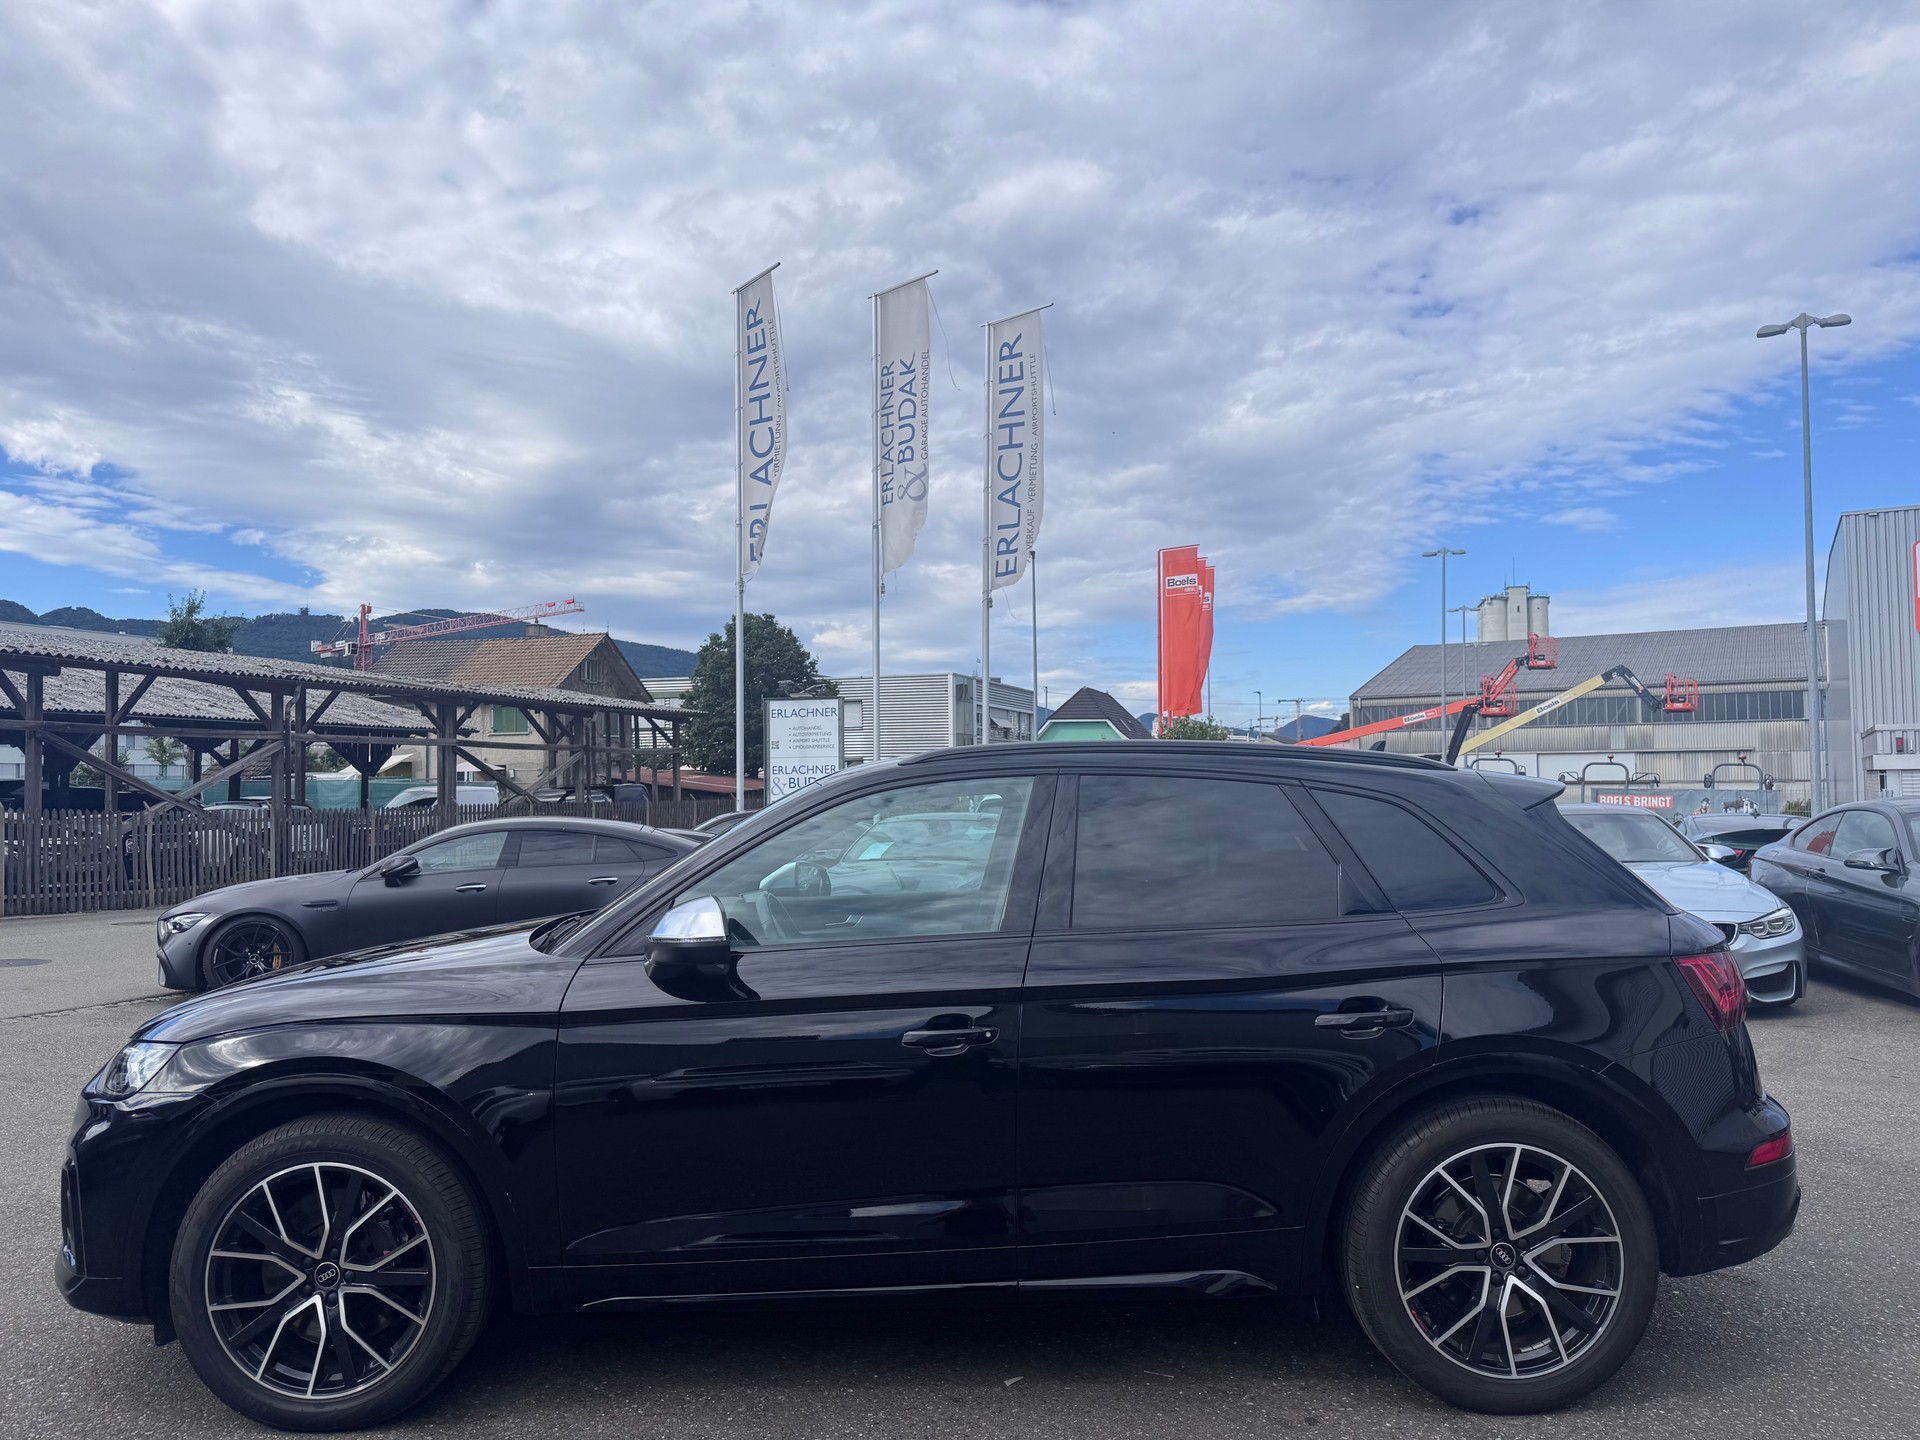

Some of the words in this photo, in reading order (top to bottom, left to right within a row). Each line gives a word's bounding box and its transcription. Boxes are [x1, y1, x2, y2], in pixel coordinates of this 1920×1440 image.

[898, 352, 917, 465] BUDAK
[921, 349, 930, 418] AUTOHANDEL
[1029, 352, 1038, 436] AIRPORTSHUTTLE
[773, 415, 782, 478] ERMIETUNG
[881, 360, 895, 505] ERLACHNER
[920, 419, 929, 460] GARAGE
[995, 332, 1025, 578] ERLACHNER
[1027, 443, 1039, 503] VERMIETUNG
[1025, 509, 1036, 550] VERKAUF
[1167, 576, 1197, 587] Boels
[771, 707, 838, 718] ERLACHNER
[772, 765, 837, 775] ERLACHNER
[1633, 796, 1672, 808] BRINGT
